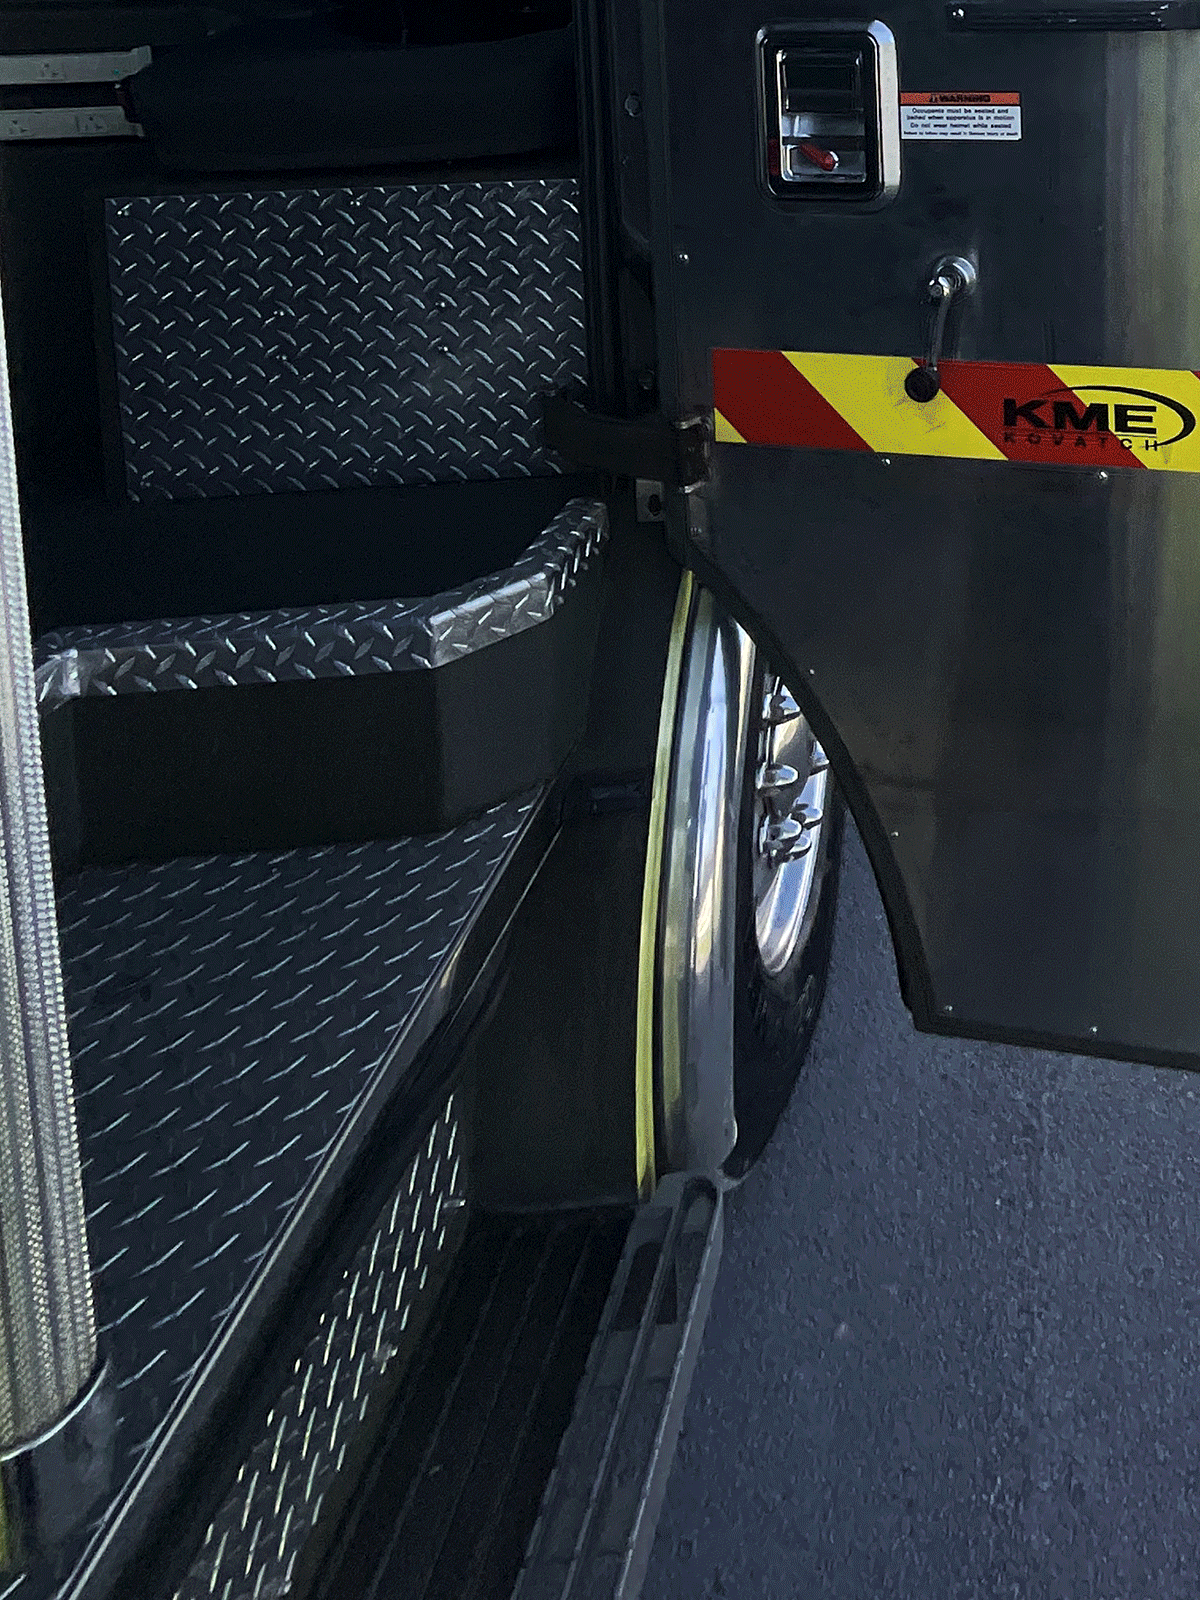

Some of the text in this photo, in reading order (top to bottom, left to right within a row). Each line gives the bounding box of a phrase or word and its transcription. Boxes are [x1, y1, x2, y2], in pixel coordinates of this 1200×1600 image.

[938, 93, 991, 103] WARNING
[1003, 398, 1157, 434] KME
[1004, 432, 1158, 452] KOVATCH
